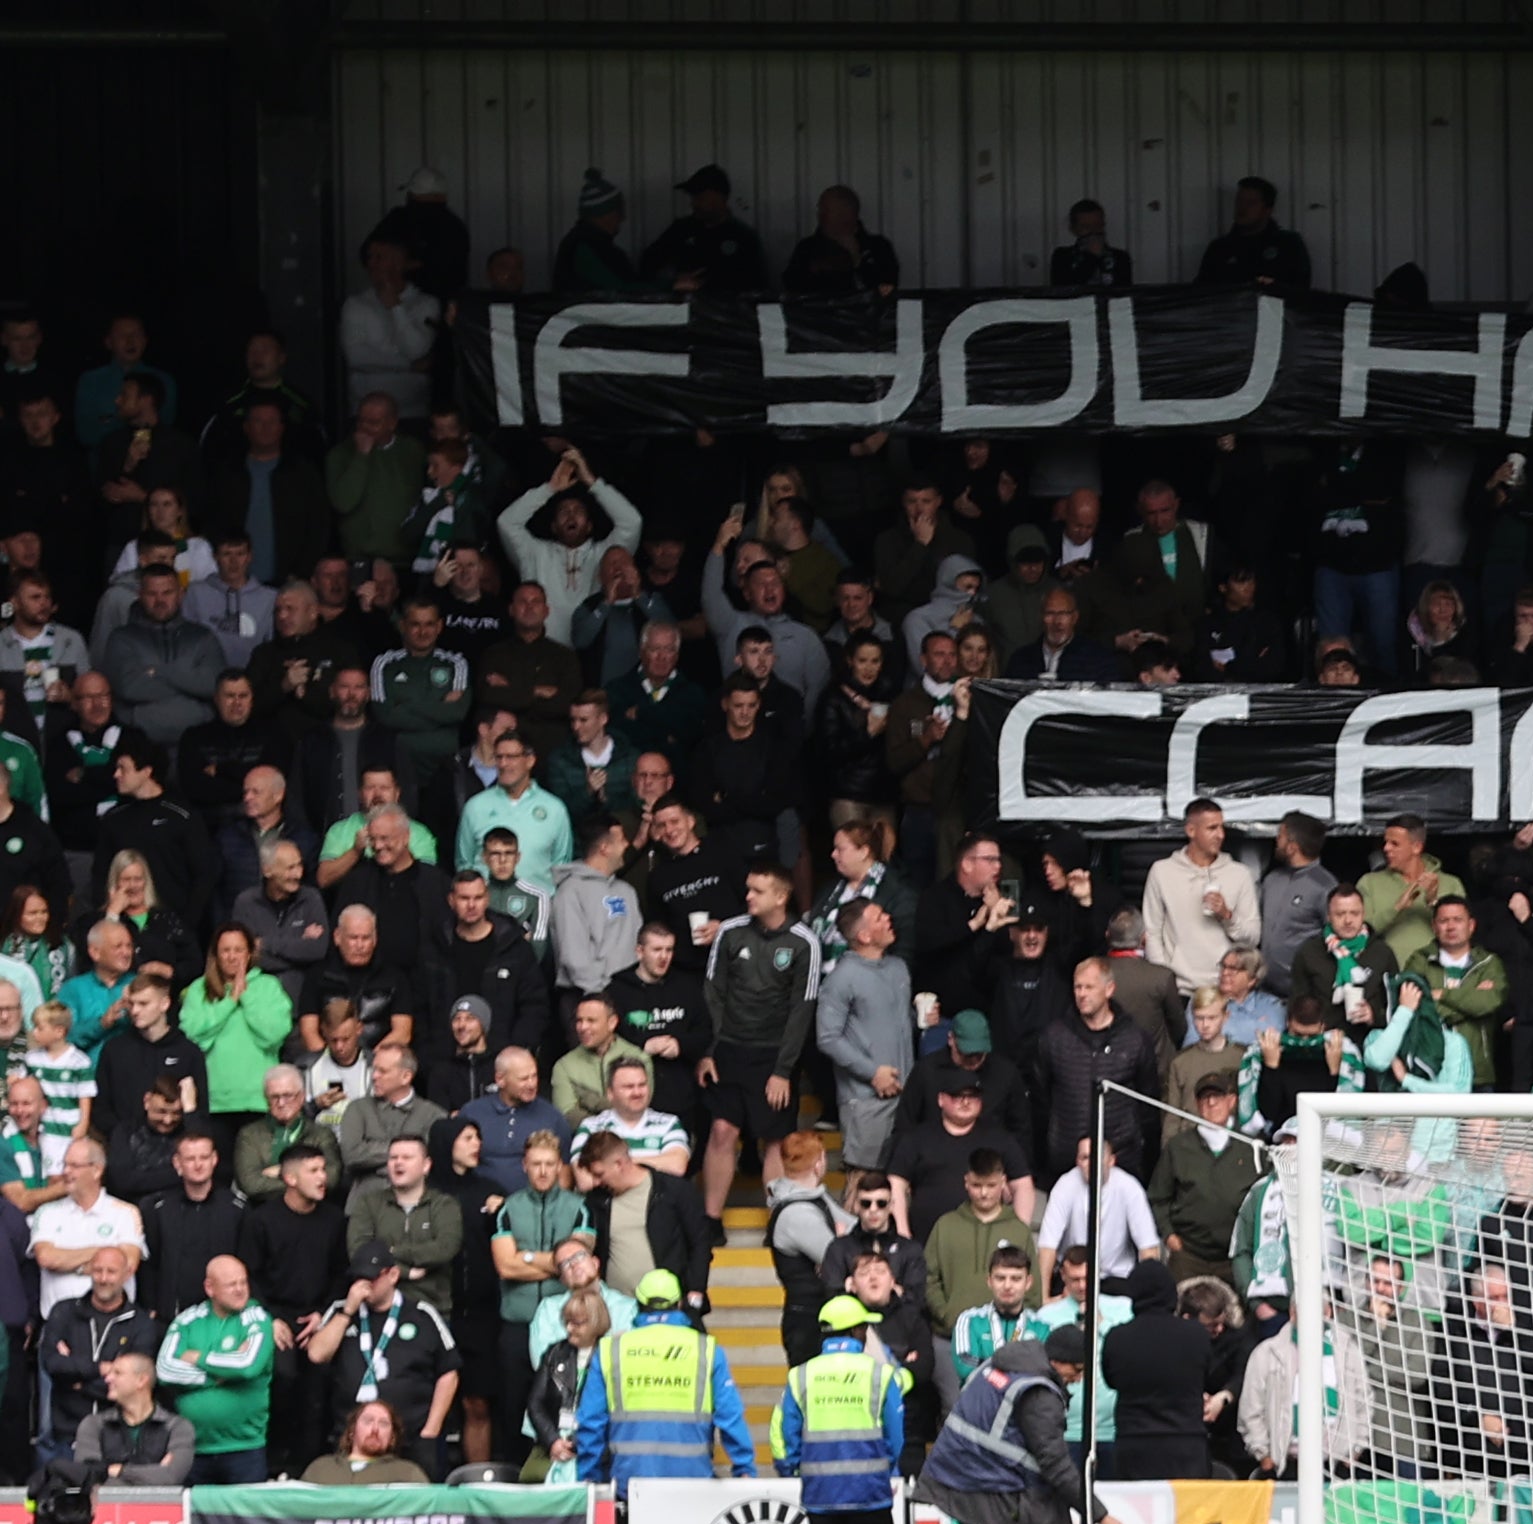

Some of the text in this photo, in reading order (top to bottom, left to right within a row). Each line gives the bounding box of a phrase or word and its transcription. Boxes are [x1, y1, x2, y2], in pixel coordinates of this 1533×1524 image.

[488, 302, 691, 427] IF
[755, 295, 1285, 433] YOU
[626, 1376, 691, 1388] STEWARD
